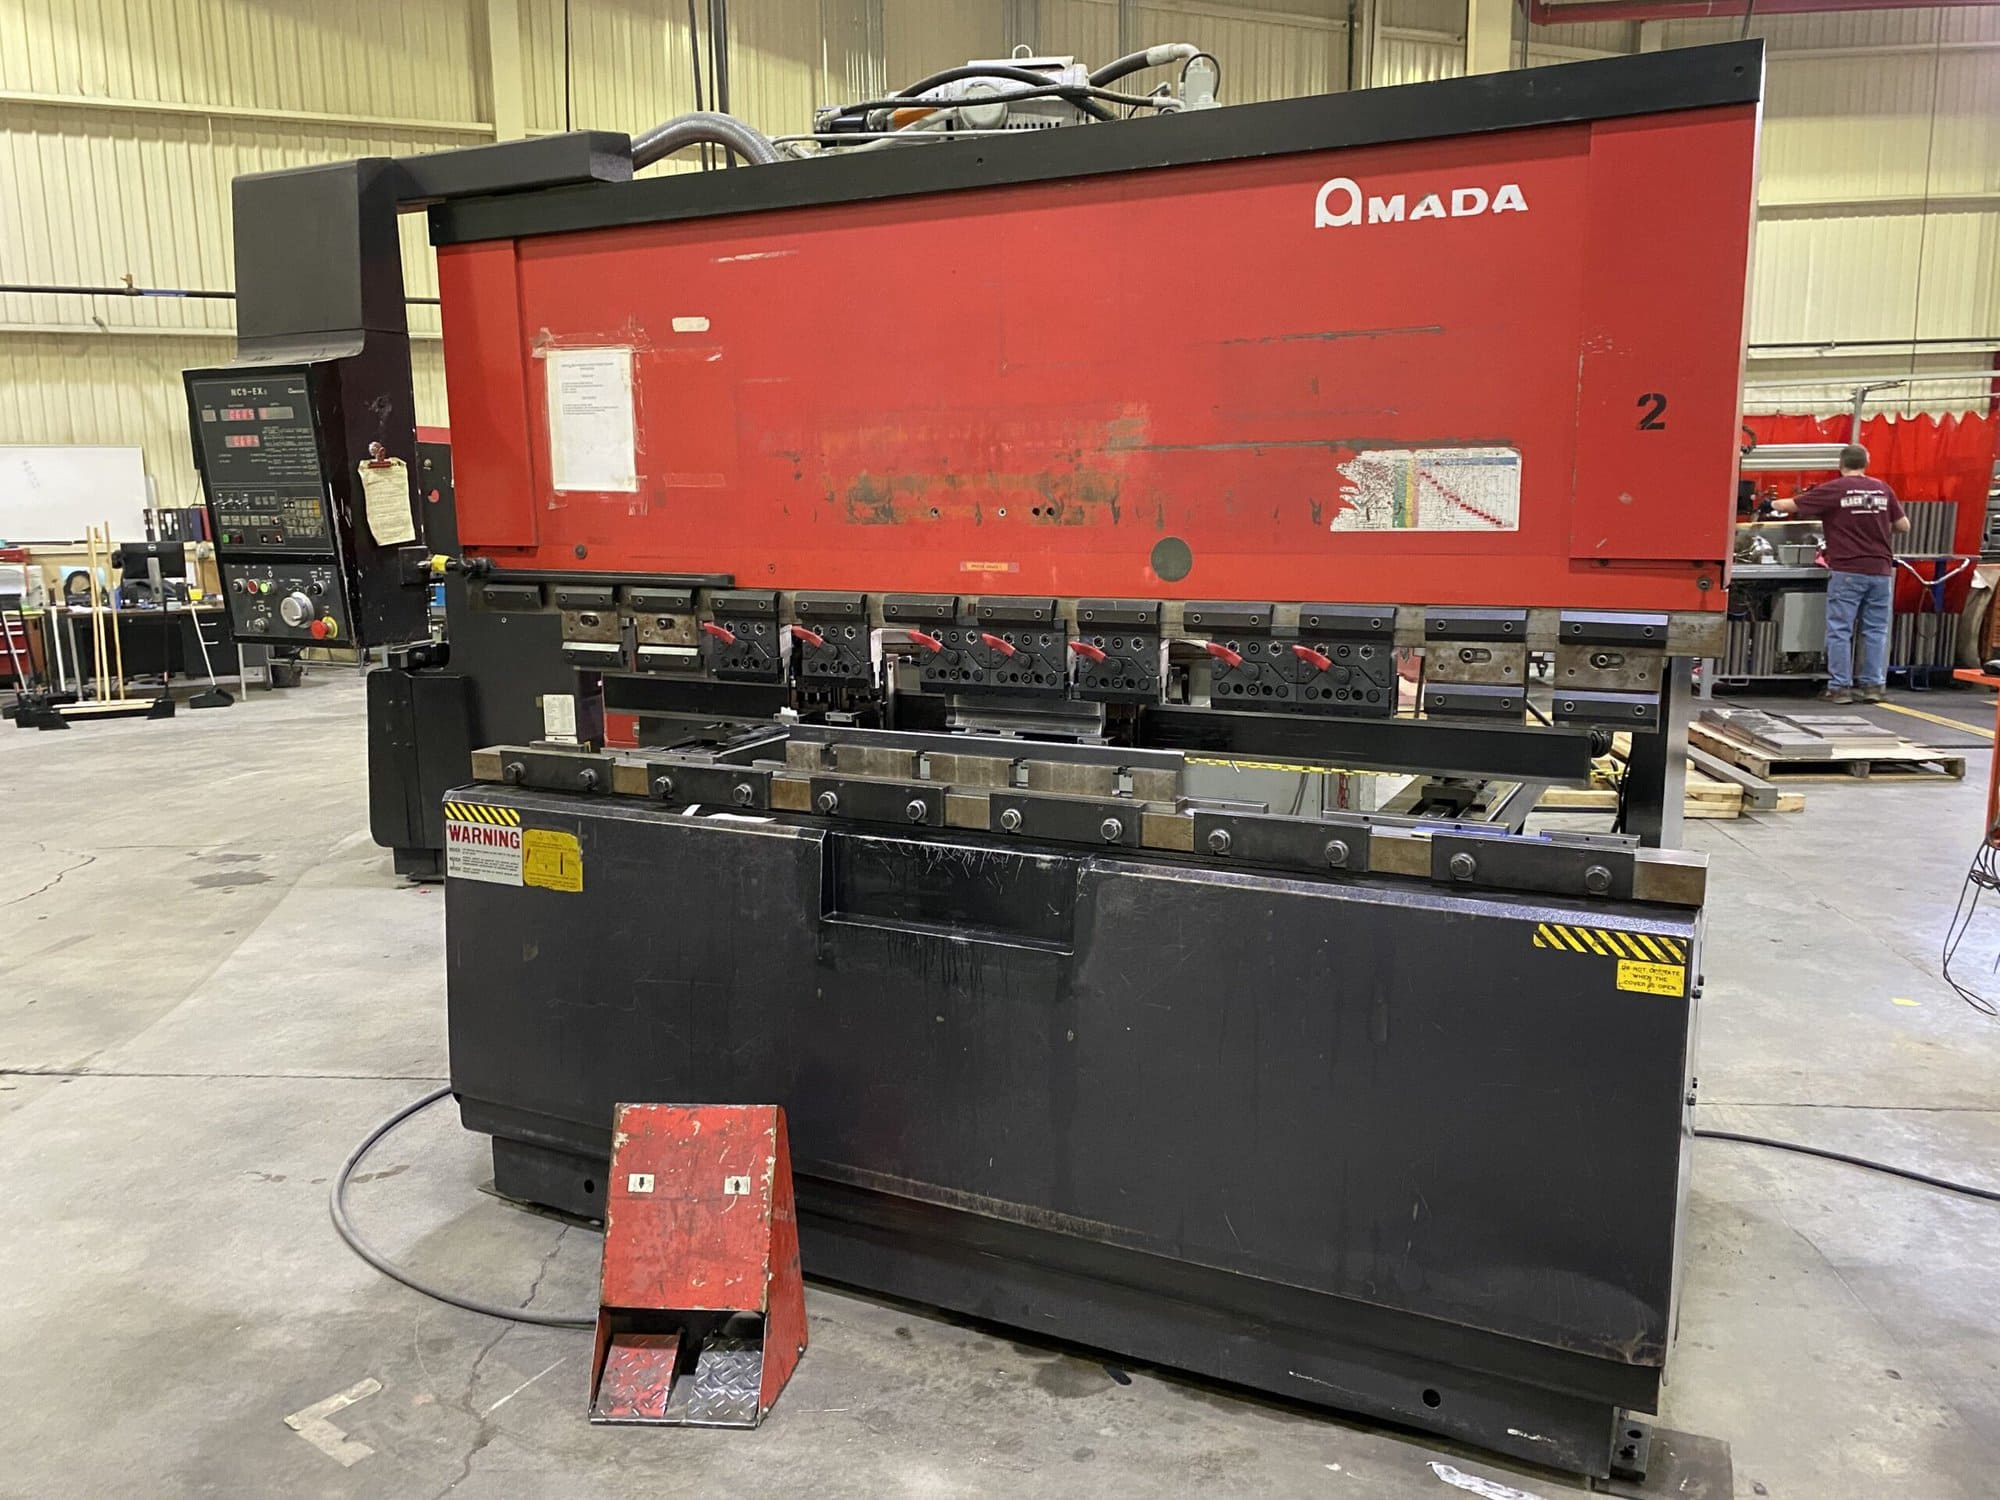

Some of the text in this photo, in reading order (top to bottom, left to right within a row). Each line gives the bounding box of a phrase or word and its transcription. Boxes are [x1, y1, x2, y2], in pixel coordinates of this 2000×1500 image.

[1315, 178, 1528, 228] AMADA
[1636, 393, 1667, 431] 2
[449, 824, 521, 850] WARNING
[1649, 968, 1681, 976] OPERATE
